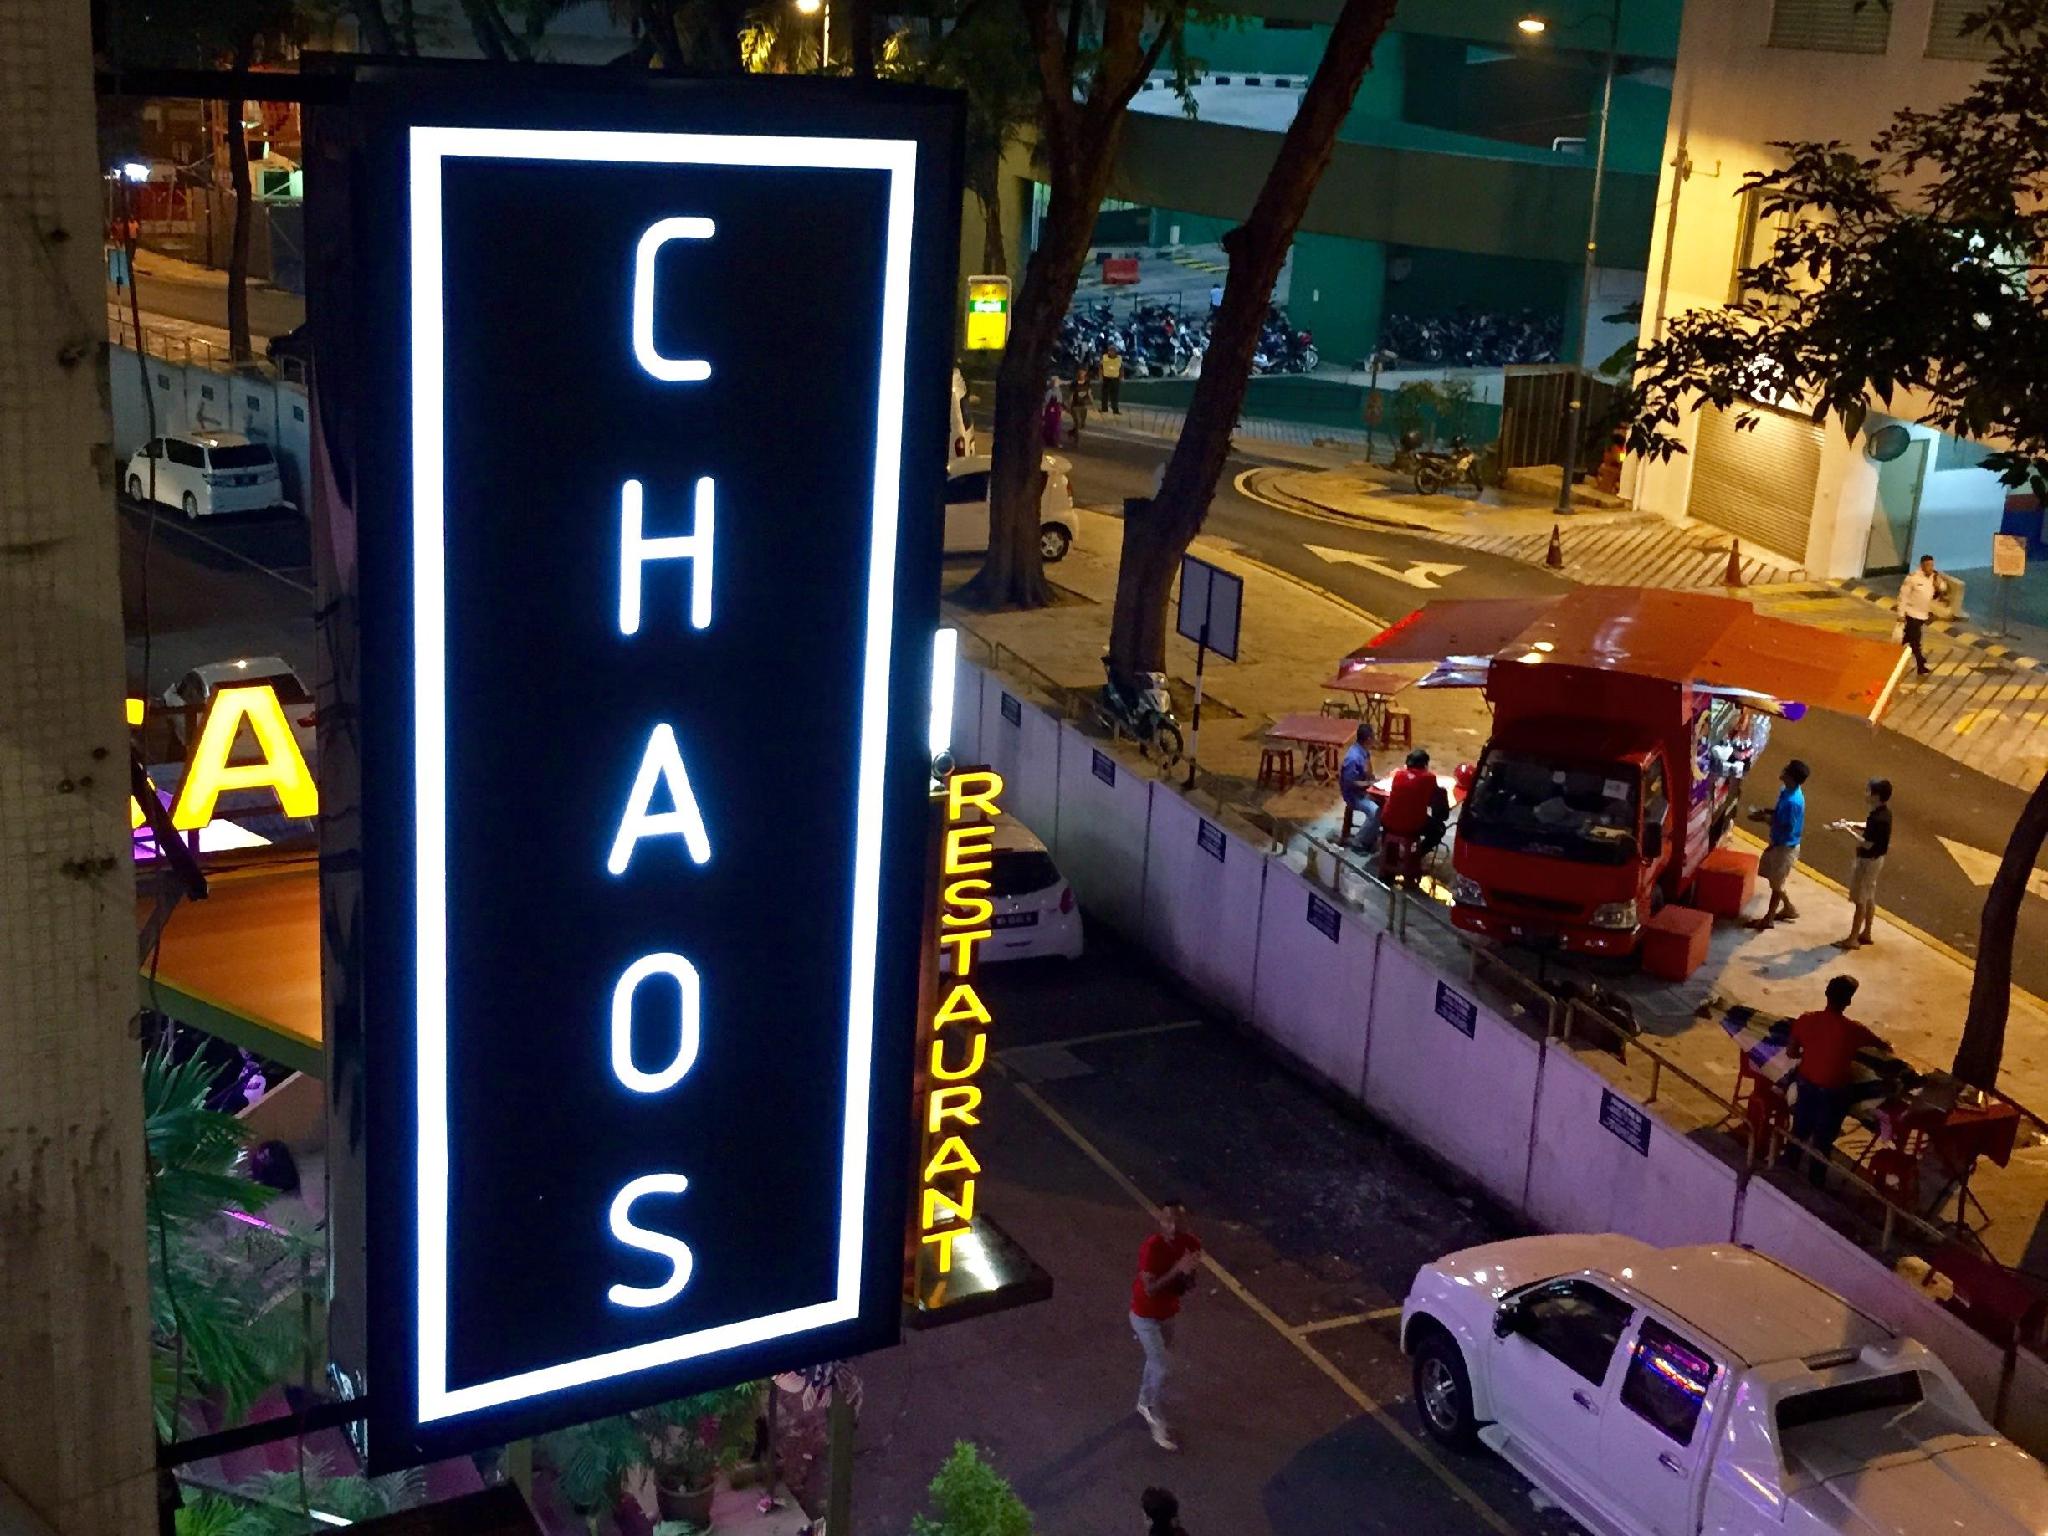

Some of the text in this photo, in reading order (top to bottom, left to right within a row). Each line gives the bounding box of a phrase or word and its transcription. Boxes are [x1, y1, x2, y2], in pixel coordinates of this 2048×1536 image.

[126, 685, 319, 830] A
[607, 216, 717, 1309] CHAOS
[921, 771, 1004, 1273] RESTAURANT
